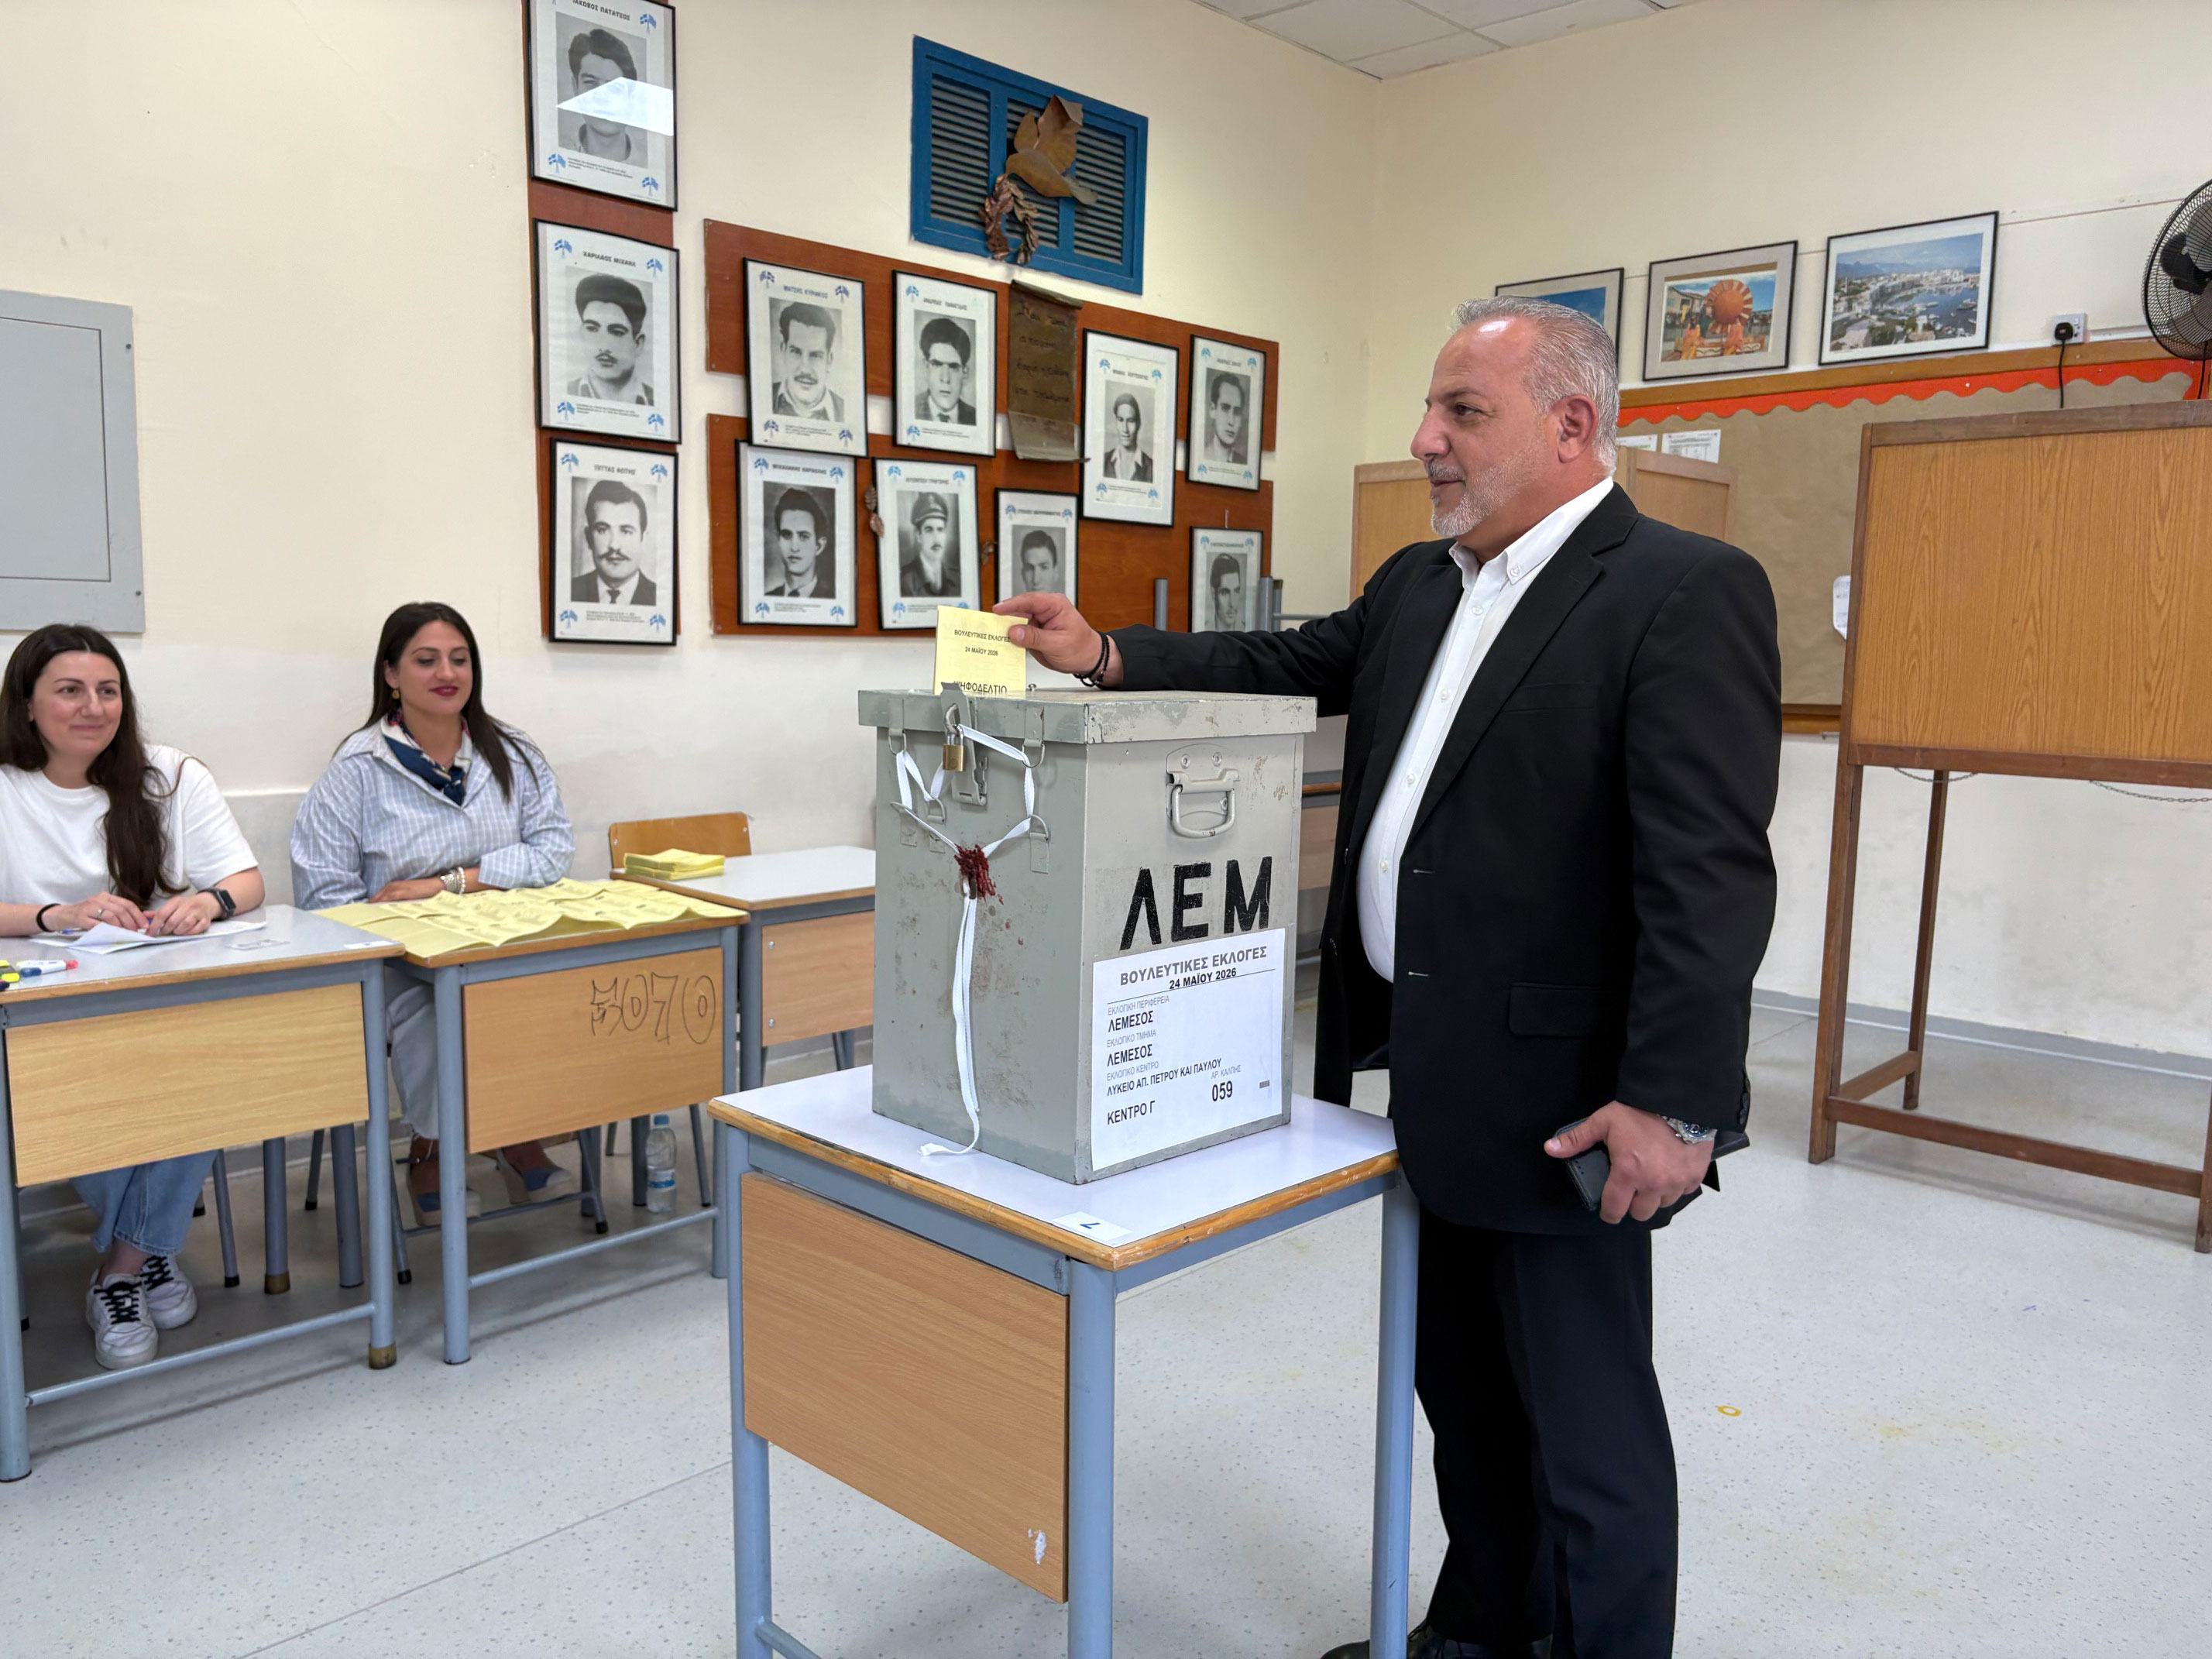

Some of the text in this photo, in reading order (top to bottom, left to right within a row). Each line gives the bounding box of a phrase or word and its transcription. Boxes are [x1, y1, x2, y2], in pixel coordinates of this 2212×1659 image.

[954, 630, 987, 640] ΒΟΥΛΕΥΤΙΚΕΣ
[1119, 856, 1272, 951] ΛΕΜ
[1120, 946, 1267, 985] ΒΟΥΛΕΥΤΙΚΕΣ ΕΚΛΟΓΕΣ
[1169, 967, 1237, 989] 24 ΜΑΪΟΥ 2026
[1108, 995, 1170, 1015] ΕΚΛΟΓΙΚΗ ΠΕΡΙΦΕΡΕΙΑ
[1108, 1010, 1153, 1032] ΛΕΜΕΣΟΣ
[1107, 1029, 1156, 1048] ΕΚΛΟΓΙΚΟ ΤΜΗΜΑ
[1107, 1043, 1152, 1066] ΛΕΜΕΣΟΣ
[1106, 1060, 1159, 1080] ΕΚΛΟΓΙΚΟ ΚΕΝΤΡΟ
[1107, 1058, 1221, 1096] ΛΥΚΕΙΟ ΑΠ. ΠΕΤΡΟΥ ΚΑΙ ΠΑΥΛΟΥ
[1221, 1065, 1242, 1077] ΚΑΛΠΗΣ
[1211, 1080, 1233, 1101] 059
[1107, 1101, 1156, 1125] ΚΕΝΤΡΟ Γ
